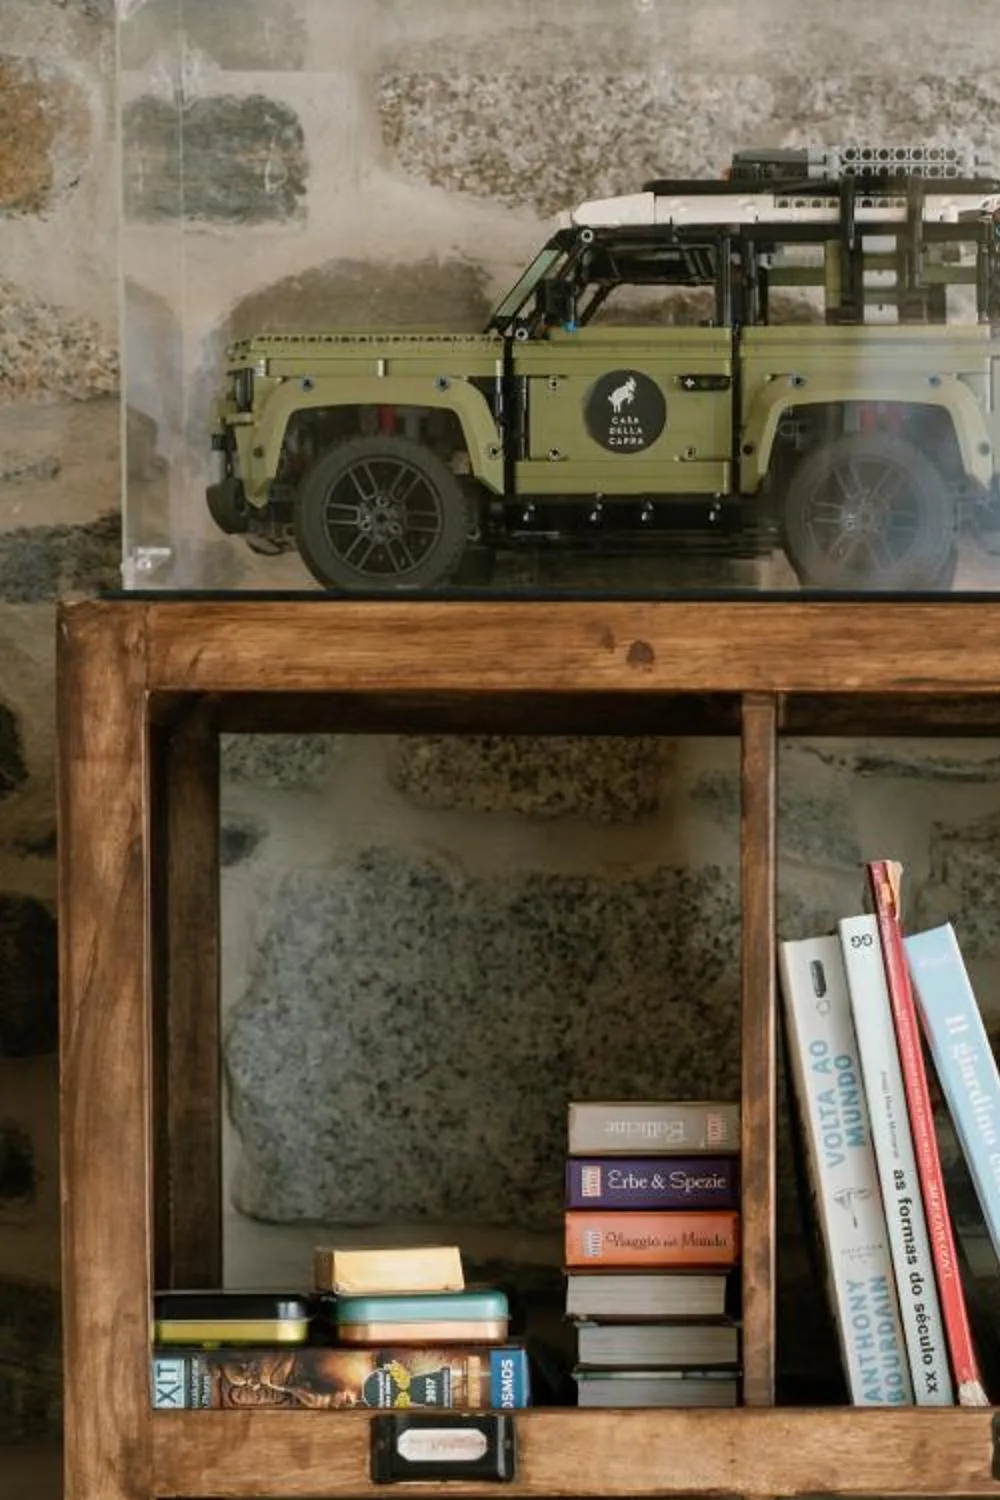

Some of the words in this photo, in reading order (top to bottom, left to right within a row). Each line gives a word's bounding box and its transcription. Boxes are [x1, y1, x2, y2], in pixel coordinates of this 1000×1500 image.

[609, 427, 643, 435] DELLA
[808, 1039, 832, 1074] AO
[834, 1054, 868, 1146] MUNDO
[951, 1043, 996, 1144] giardino
[816, 1088, 846, 1167] VOLTA
[607, 1168, 647, 1189] Erbe
[650, 1172, 664, 1189] &
[669, 1170, 725, 1193] Spezie
[892, 1169, 906, 1190] as
[897, 1197, 917, 1265] formas
[908, 1271, 925, 1296] do
[846, 1279, 883, 1402] ANTHONY
[870, 1275, 910, 1402] BOURDAIN
[913, 1303, 935, 1365] século
[924, 1371, 938, 1394] xx
